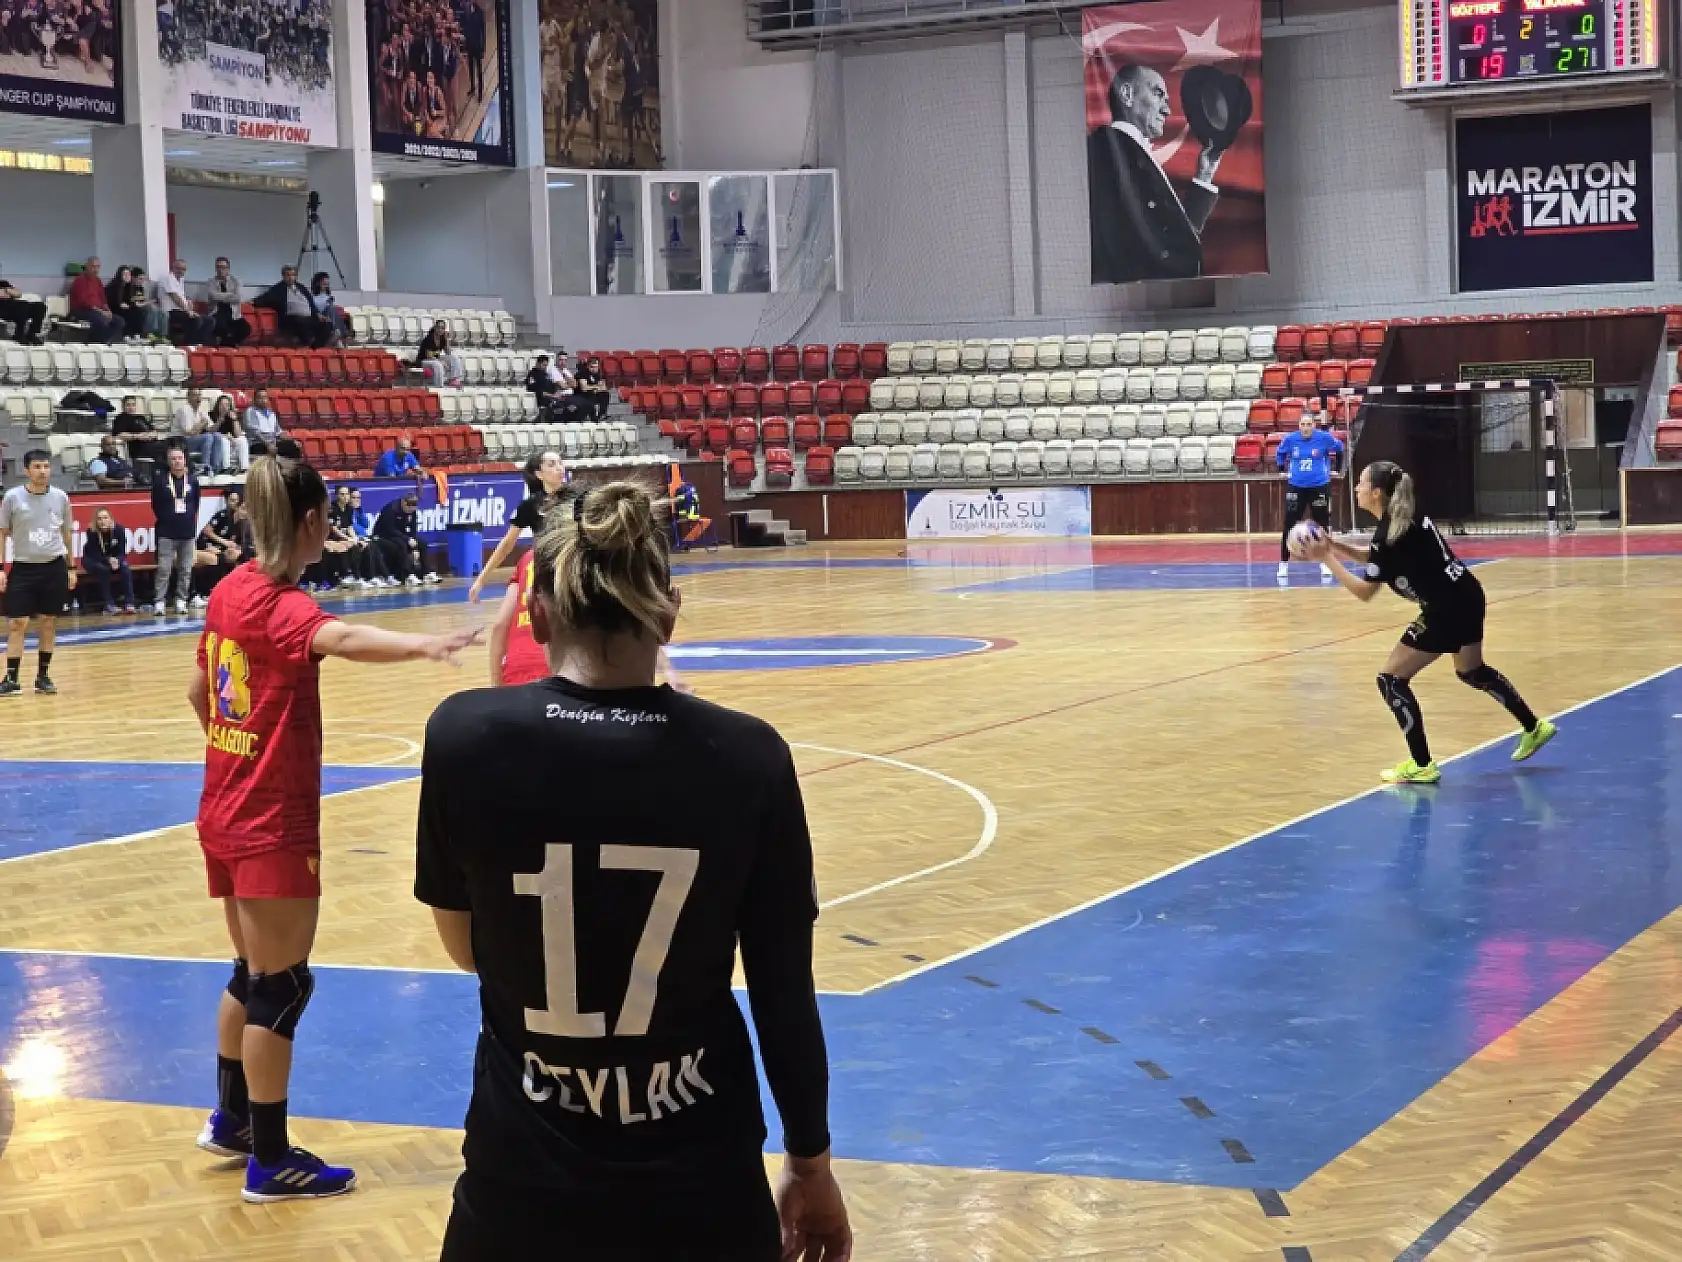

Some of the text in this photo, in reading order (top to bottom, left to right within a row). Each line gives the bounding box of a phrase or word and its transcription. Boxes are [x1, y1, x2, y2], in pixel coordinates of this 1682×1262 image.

[1473, 24, 1486, 44] 0
[1519, 19, 1533, 40] 2
[1582, 14, 1595, 34] 0
[1481, 54, 1504, 78] 19
[1558, 47, 1589, 71] 27
[32, 91, 54, 107] CUP
[1467, 160, 1637, 196] MARATON
[453, 487, 505, 527] İZMİR
[1017, 502, 1046, 518] SU
[513, 843, 700, 1038] 17
[522, 1048, 715, 1125] CEYLAN
